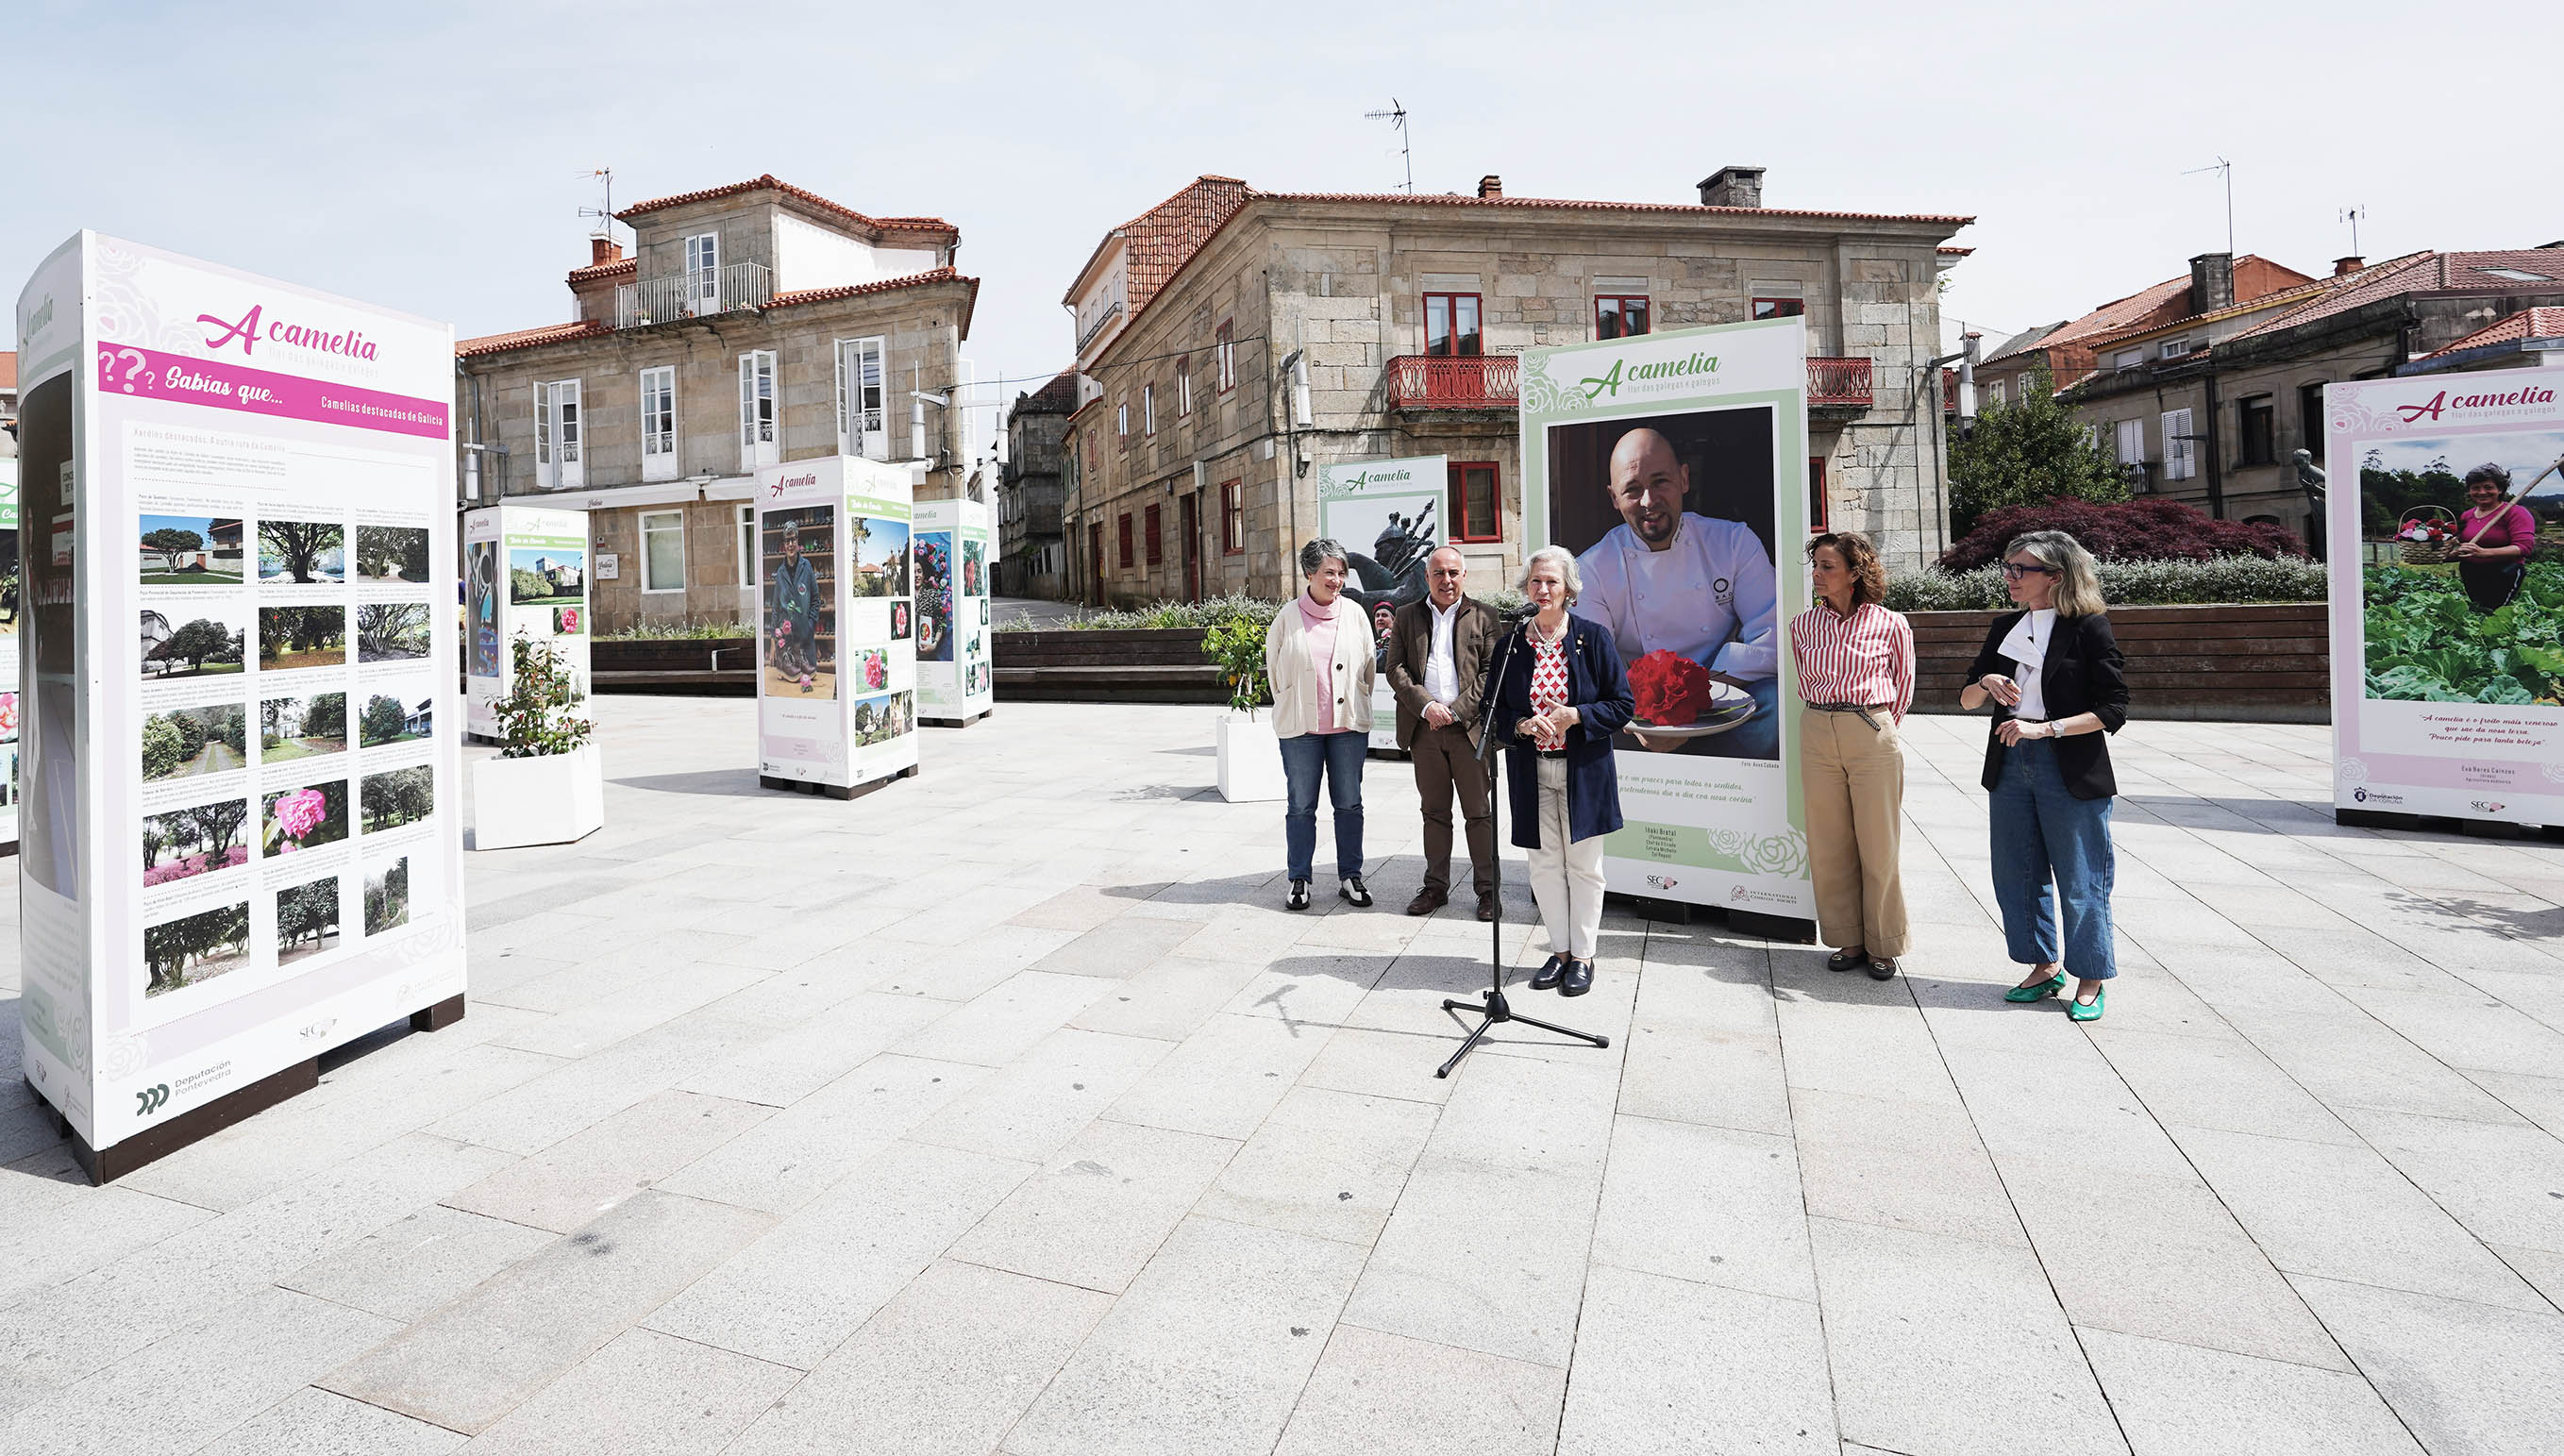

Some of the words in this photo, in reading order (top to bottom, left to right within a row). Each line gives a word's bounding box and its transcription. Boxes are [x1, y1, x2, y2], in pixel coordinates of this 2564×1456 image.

[196, 304, 262, 356] A
[269, 321, 379, 361] camelia
[164, 366, 232, 397] Sabías
[238, 383, 283, 406] que...
[1580, 359, 1623, 399] A
[1628, 352, 1721, 381] camelia
[321, 396, 360, 413] Camelias
[361, 403, 406, 421] destacadas
[408, 410, 417, 423] de
[418, 411, 444, 427] Galicia
[2396, 391, 2446, 423] A
[2452, 386, 2558, 410] camelia
[2524, 406, 2556, 416] galegos
[771, 475, 785, 498] A
[785, 473, 816, 488] camelia
[1346, 470, 1366, 492] A
[1368, 469, 1412, 483] camelia
[2454, 734, 2471, 743] pide
[2494, 736, 2514, 745] tanta
[1684, 778, 1702, 787] todos
[2471, 800, 2489, 809] SEC
[1647, 875, 1663, 885] SEC
[1750, 890, 1797, 900] INTERNATIONAL
[175, 1068, 231, 1097] Pontevedra
